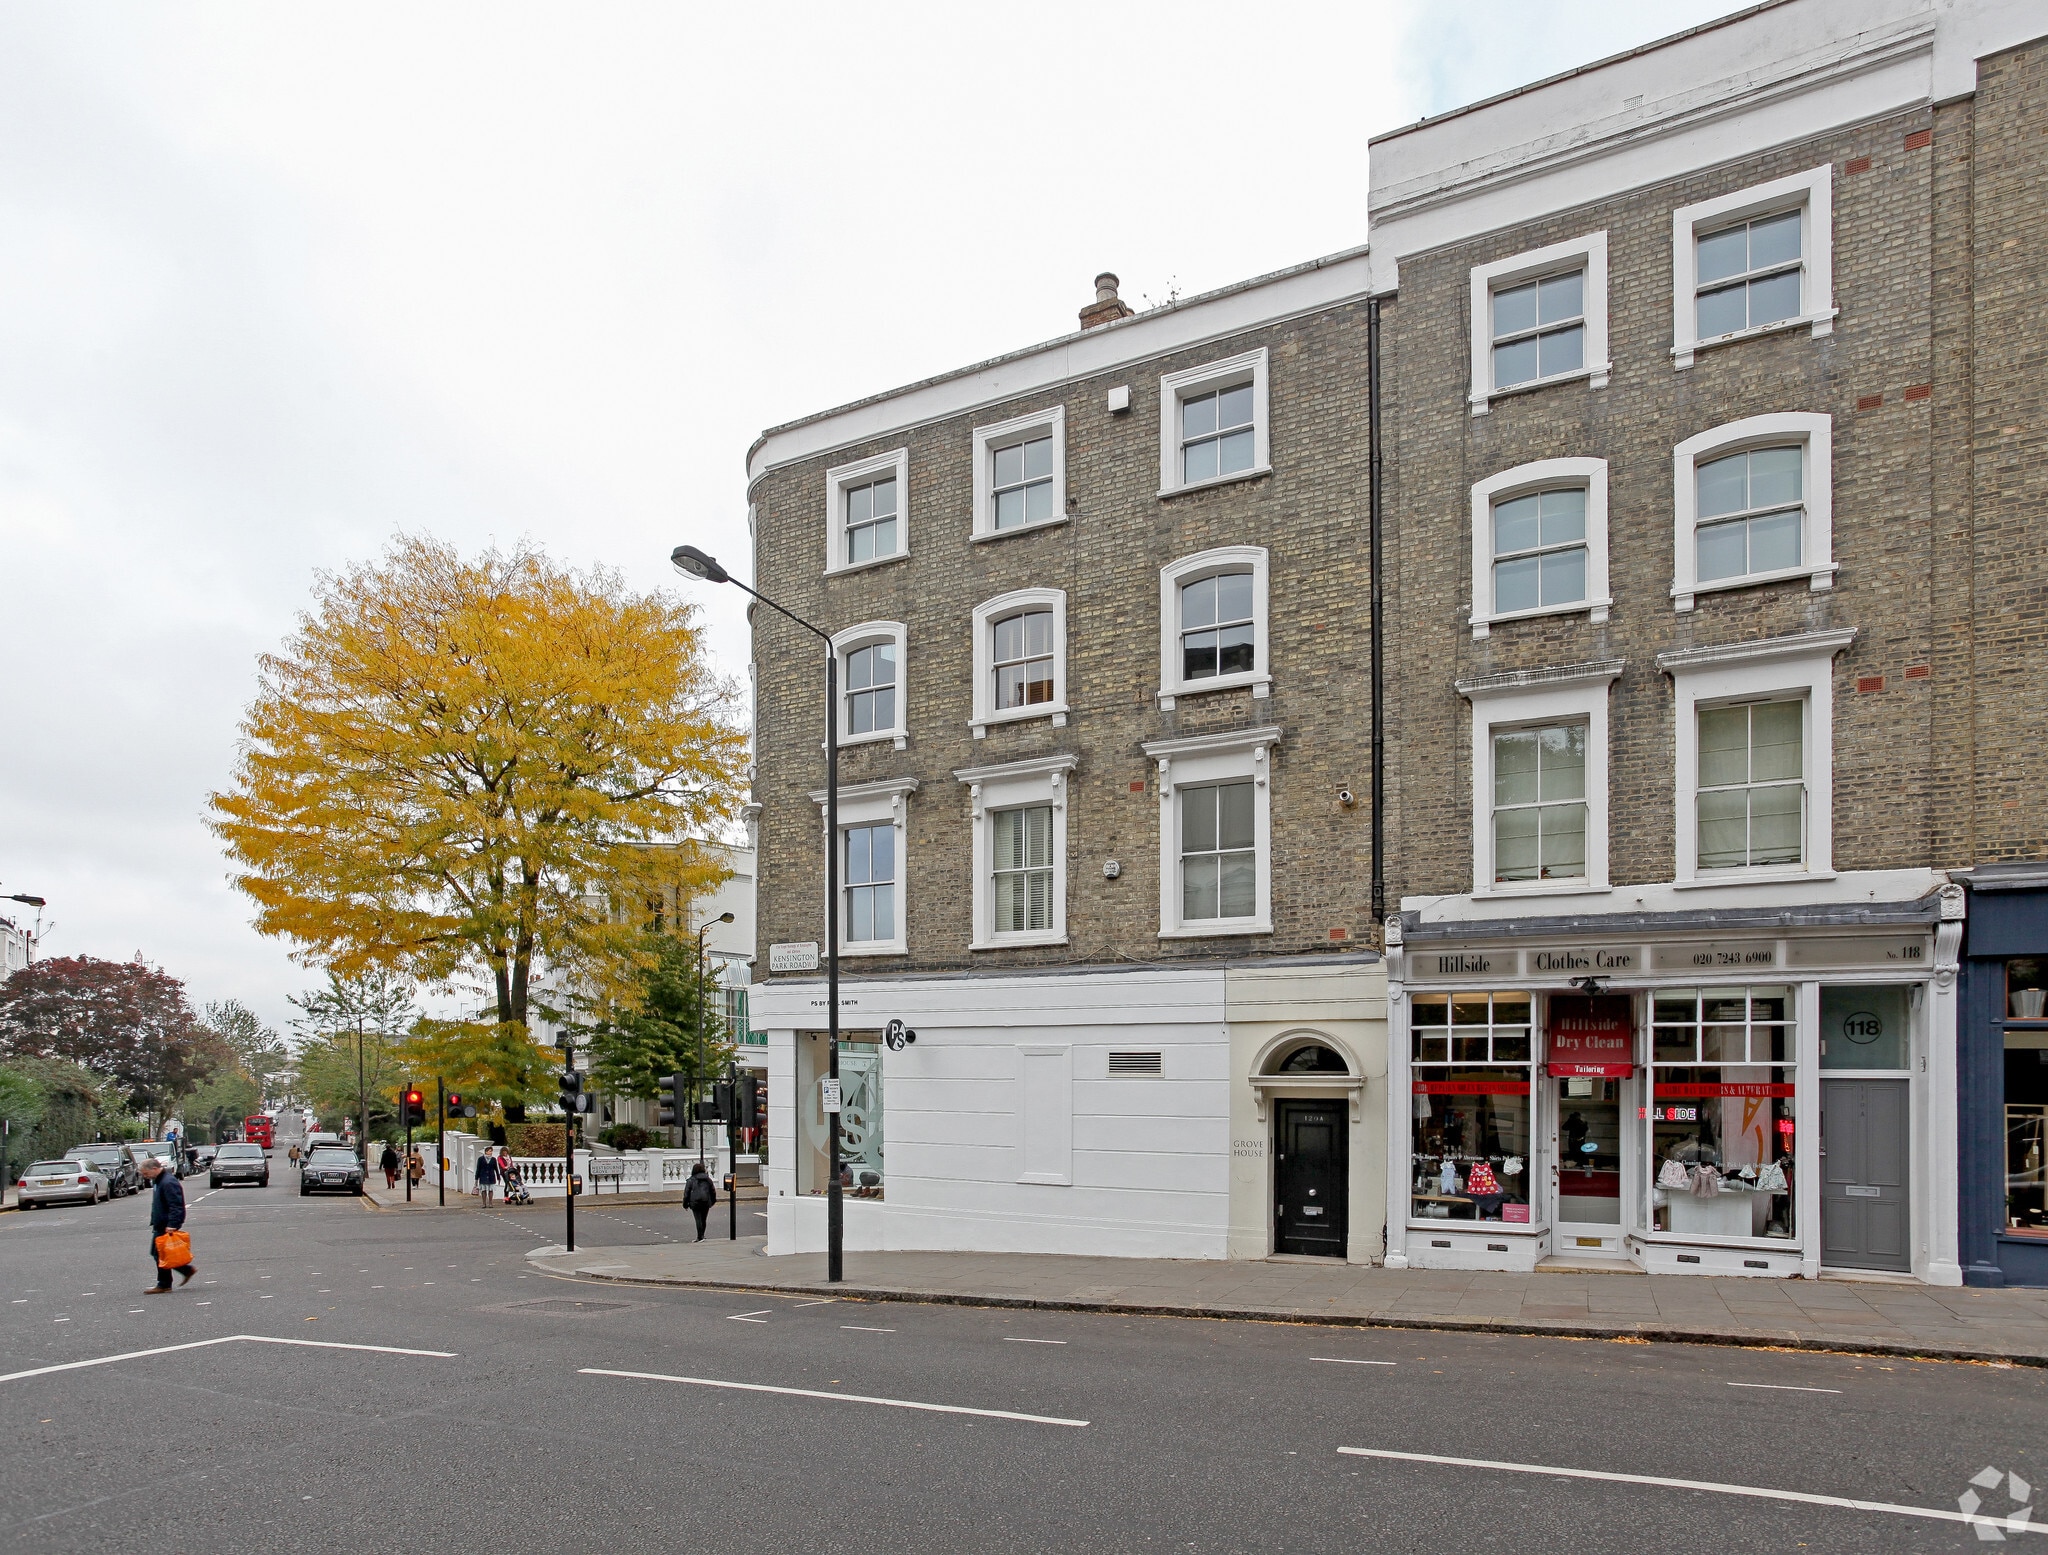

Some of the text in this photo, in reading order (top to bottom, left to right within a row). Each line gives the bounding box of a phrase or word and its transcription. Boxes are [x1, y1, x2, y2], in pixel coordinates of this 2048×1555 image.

[773, 953, 815, 962] KENSINGTON
[1692, 951, 1772, 965] 020 7243 6900
[1886, 946, 1920, 960] No. 118
[789, 961, 807, 969] ROAD
[1438, 950, 1631, 973] Hillside Clothes Care
[1561, 1017, 1619, 1031] Hillside
[1846, 1020, 1879, 1036] 118
[1556, 1034, 1625, 1050] Dry Clean
[1574, 1064, 1605, 1074] Tailoring
[1729, 1085, 1736, 1095] &
[1233, 1140, 1264, 1148] GROVE
[1233, 1149, 1263, 1157] HOUSE
